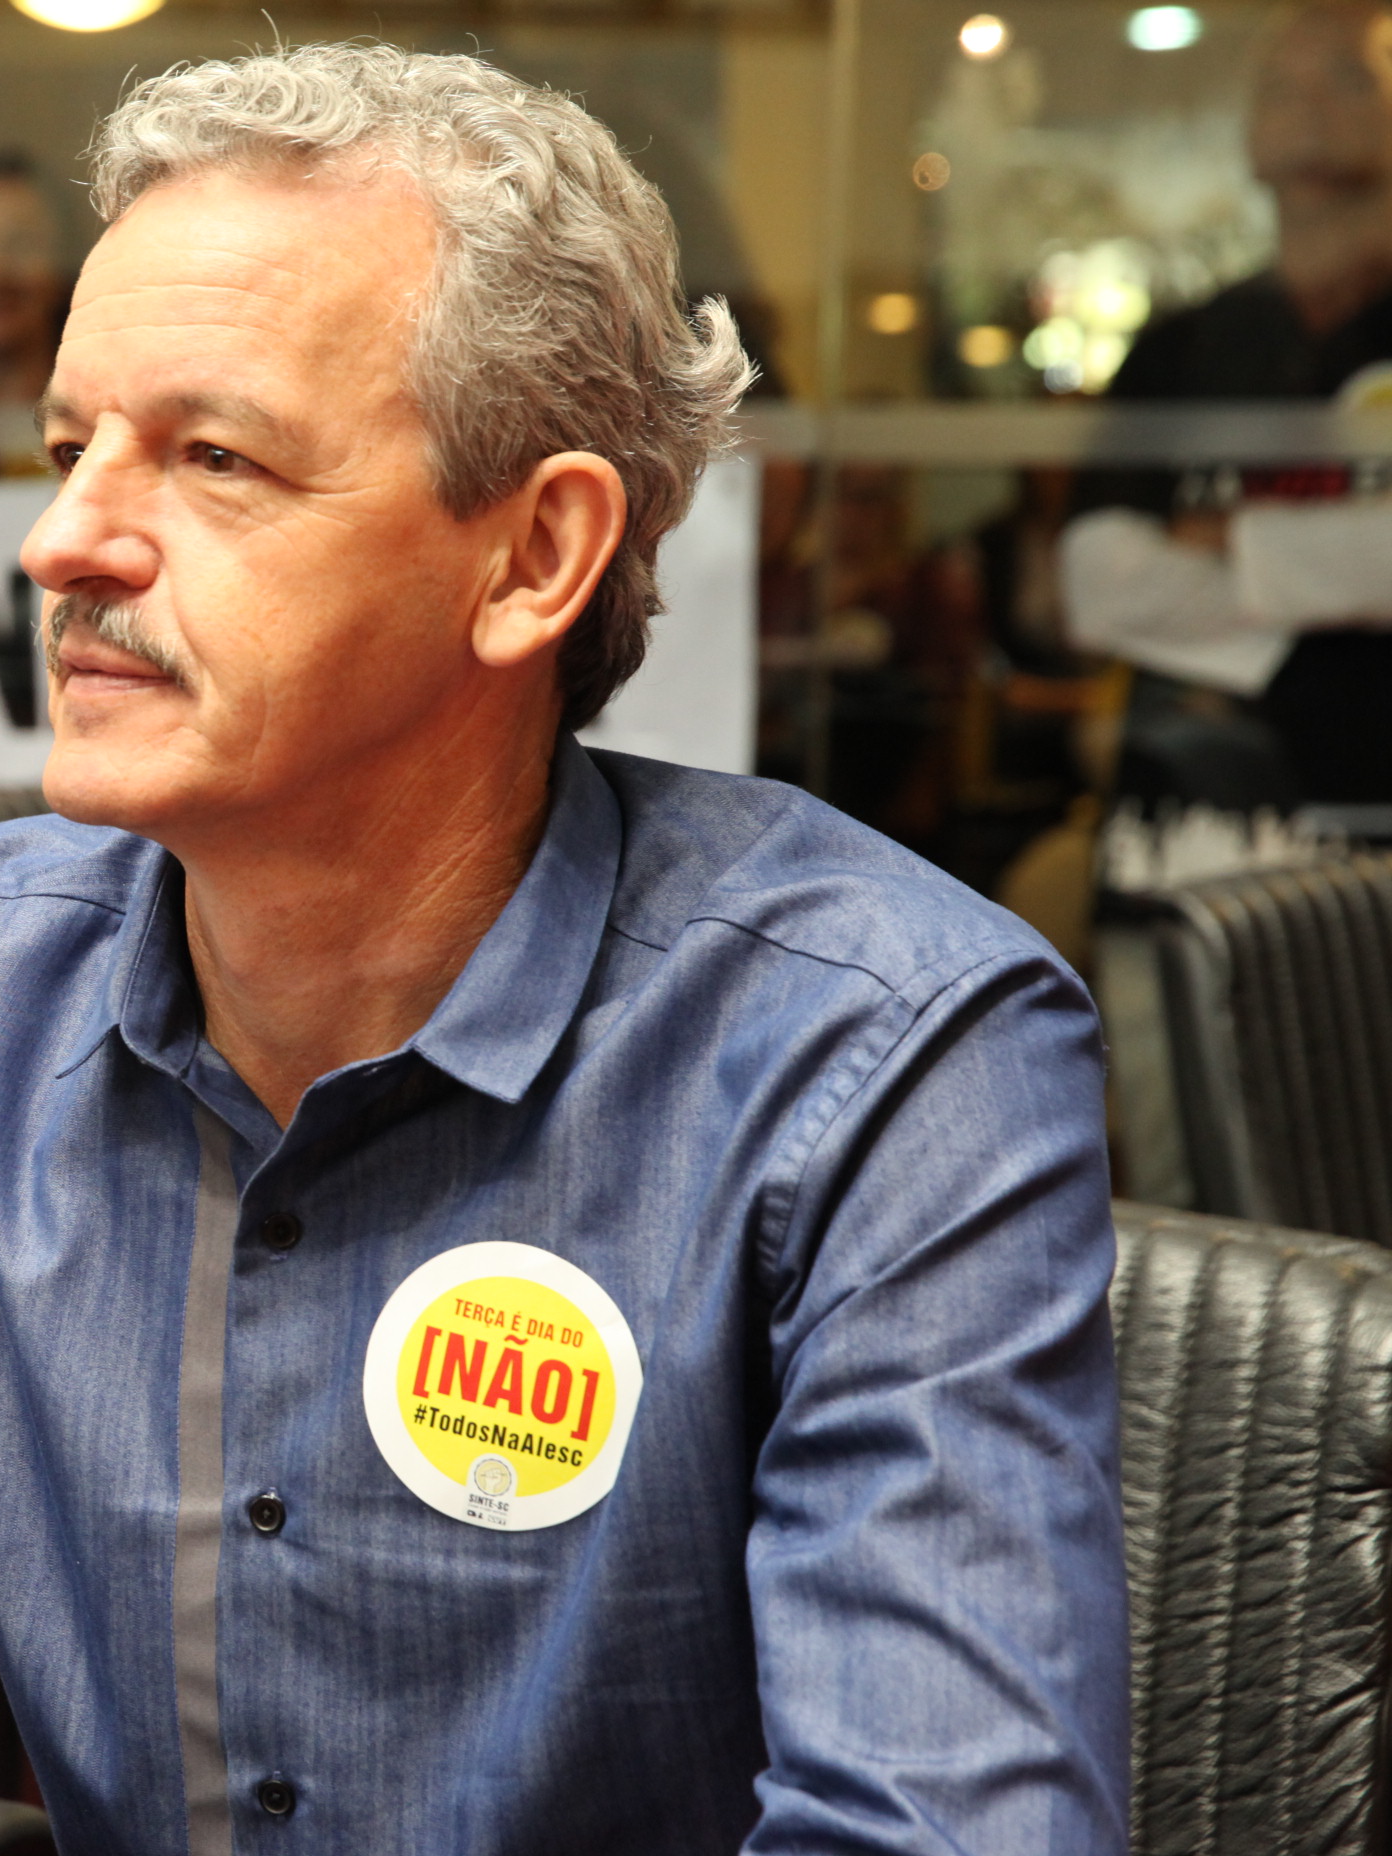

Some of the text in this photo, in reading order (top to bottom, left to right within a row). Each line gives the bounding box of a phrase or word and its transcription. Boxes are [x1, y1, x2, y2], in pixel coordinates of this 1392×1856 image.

[454, 1299, 585, 1348] TERÇA É DIA DO
[413, 1404, 584, 1467] #TodosNaAlesc
